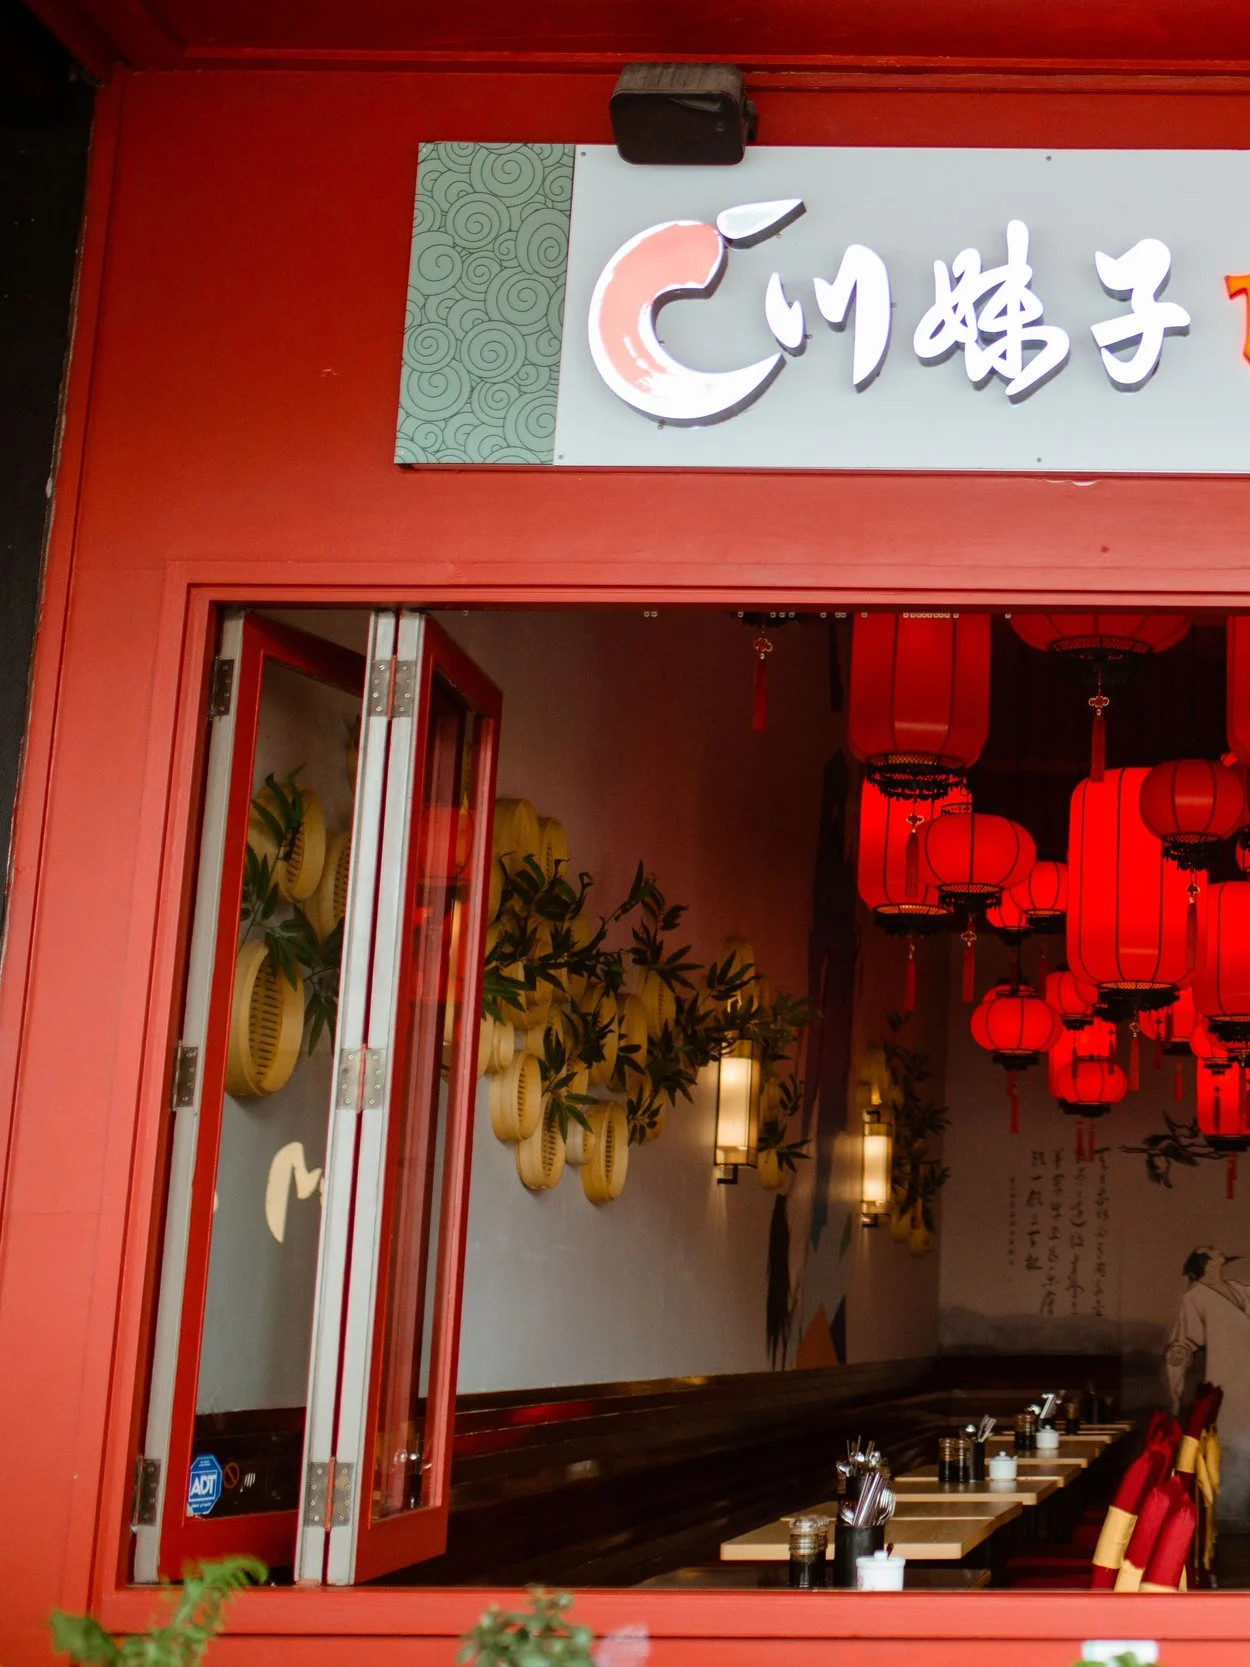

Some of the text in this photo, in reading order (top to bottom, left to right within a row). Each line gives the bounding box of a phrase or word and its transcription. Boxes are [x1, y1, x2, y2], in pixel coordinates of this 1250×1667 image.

[764, 219, 1191, 402] 川妹子
[191, 1475, 216, 1495] ADT
